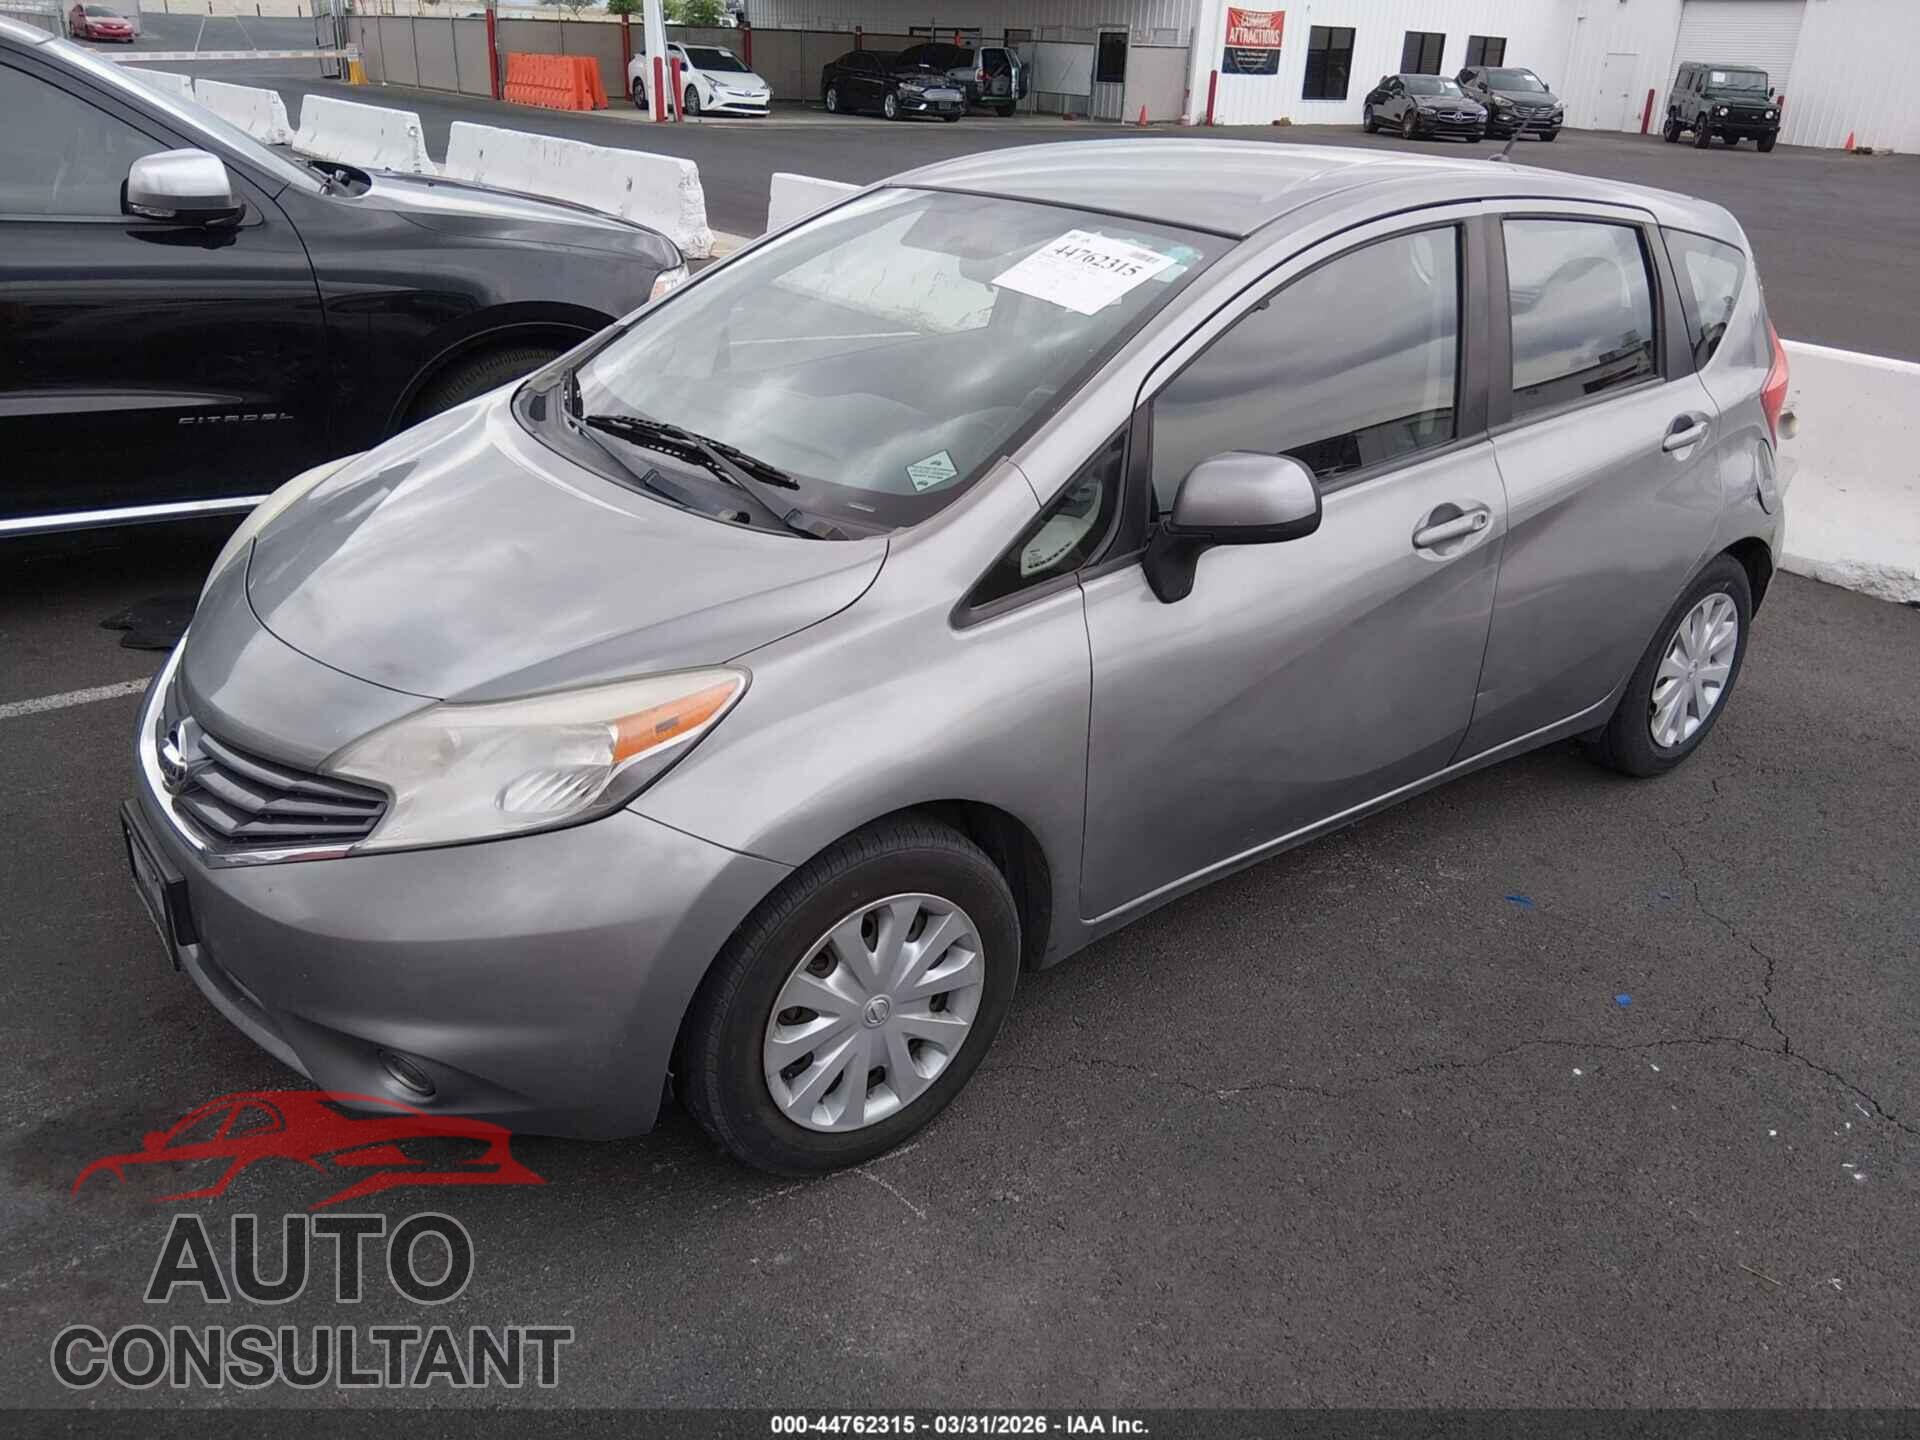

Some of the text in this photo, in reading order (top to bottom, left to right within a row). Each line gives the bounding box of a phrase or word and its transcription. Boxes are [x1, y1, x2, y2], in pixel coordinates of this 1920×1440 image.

[1228, 26, 1281, 45] ATTRACTIONS
[1054, 243, 1144, 277] 44762315
[178, 412, 295, 425] CITADEL
